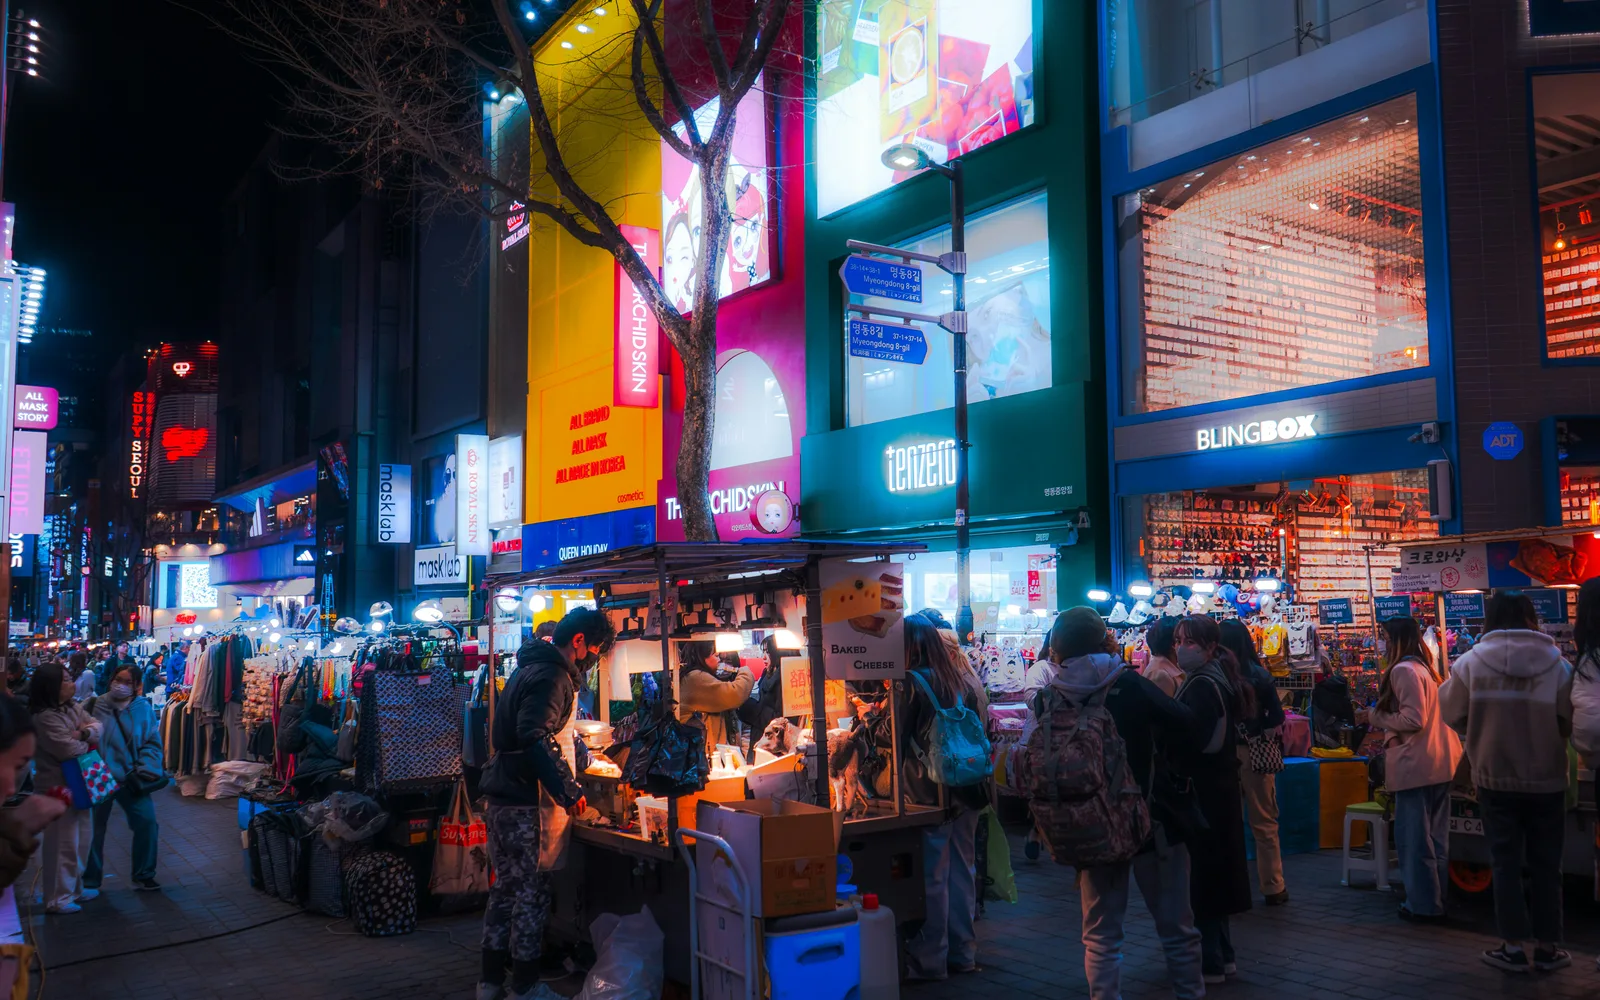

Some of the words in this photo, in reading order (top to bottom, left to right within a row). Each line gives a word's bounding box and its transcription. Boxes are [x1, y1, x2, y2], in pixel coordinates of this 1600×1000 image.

[890, 267, 920, 282] 명동8길
[863, 275, 904, 290] Myeongdong
[906, 283, 920, 292] 8-gil
[852, 323, 883, 338] 명동8길
[852, 337, 894, 350] Myeongdong
[895, 343, 911, 352] 8-gil
[25, 392, 44, 401] ALL
[19, 402, 48, 411] MASK
[17, 412, 49, 422] STORY
[131, 391, 144, 438] SUPY
[569, 413, 583, 431] ALL
[583, 405, 610, 426] BRAND
[571, 438, 586, 455] ALL
[586, 432, 607, 451] MASK
[1490, 434, 1517, 448] ADT
[129, 441, 142, 499] SEOUL
[555, 468, 569, 484] ALL
[569, 462, 591, 482] MADE
[590, 459, 600, 477] IN
[600, 455, 626, 475] KOREA
[885, 439, 957, 492] tenzero
[11, 447, 31, 518] ETUDE
[469, 472, 478, 513] ROYAL
[617, 489, 644, 504] cosmetics
[1043, 485, 1073, 497] 명동중앙점
[468, 514, 478, 544] SKIN
[559, 548, 579, 561] QUEEN
[1407, 548, 1467, 565] 크로와상
[1011, 587, 1026, 595] SALE
[1321, 603, 1347, 611] KEYRING
